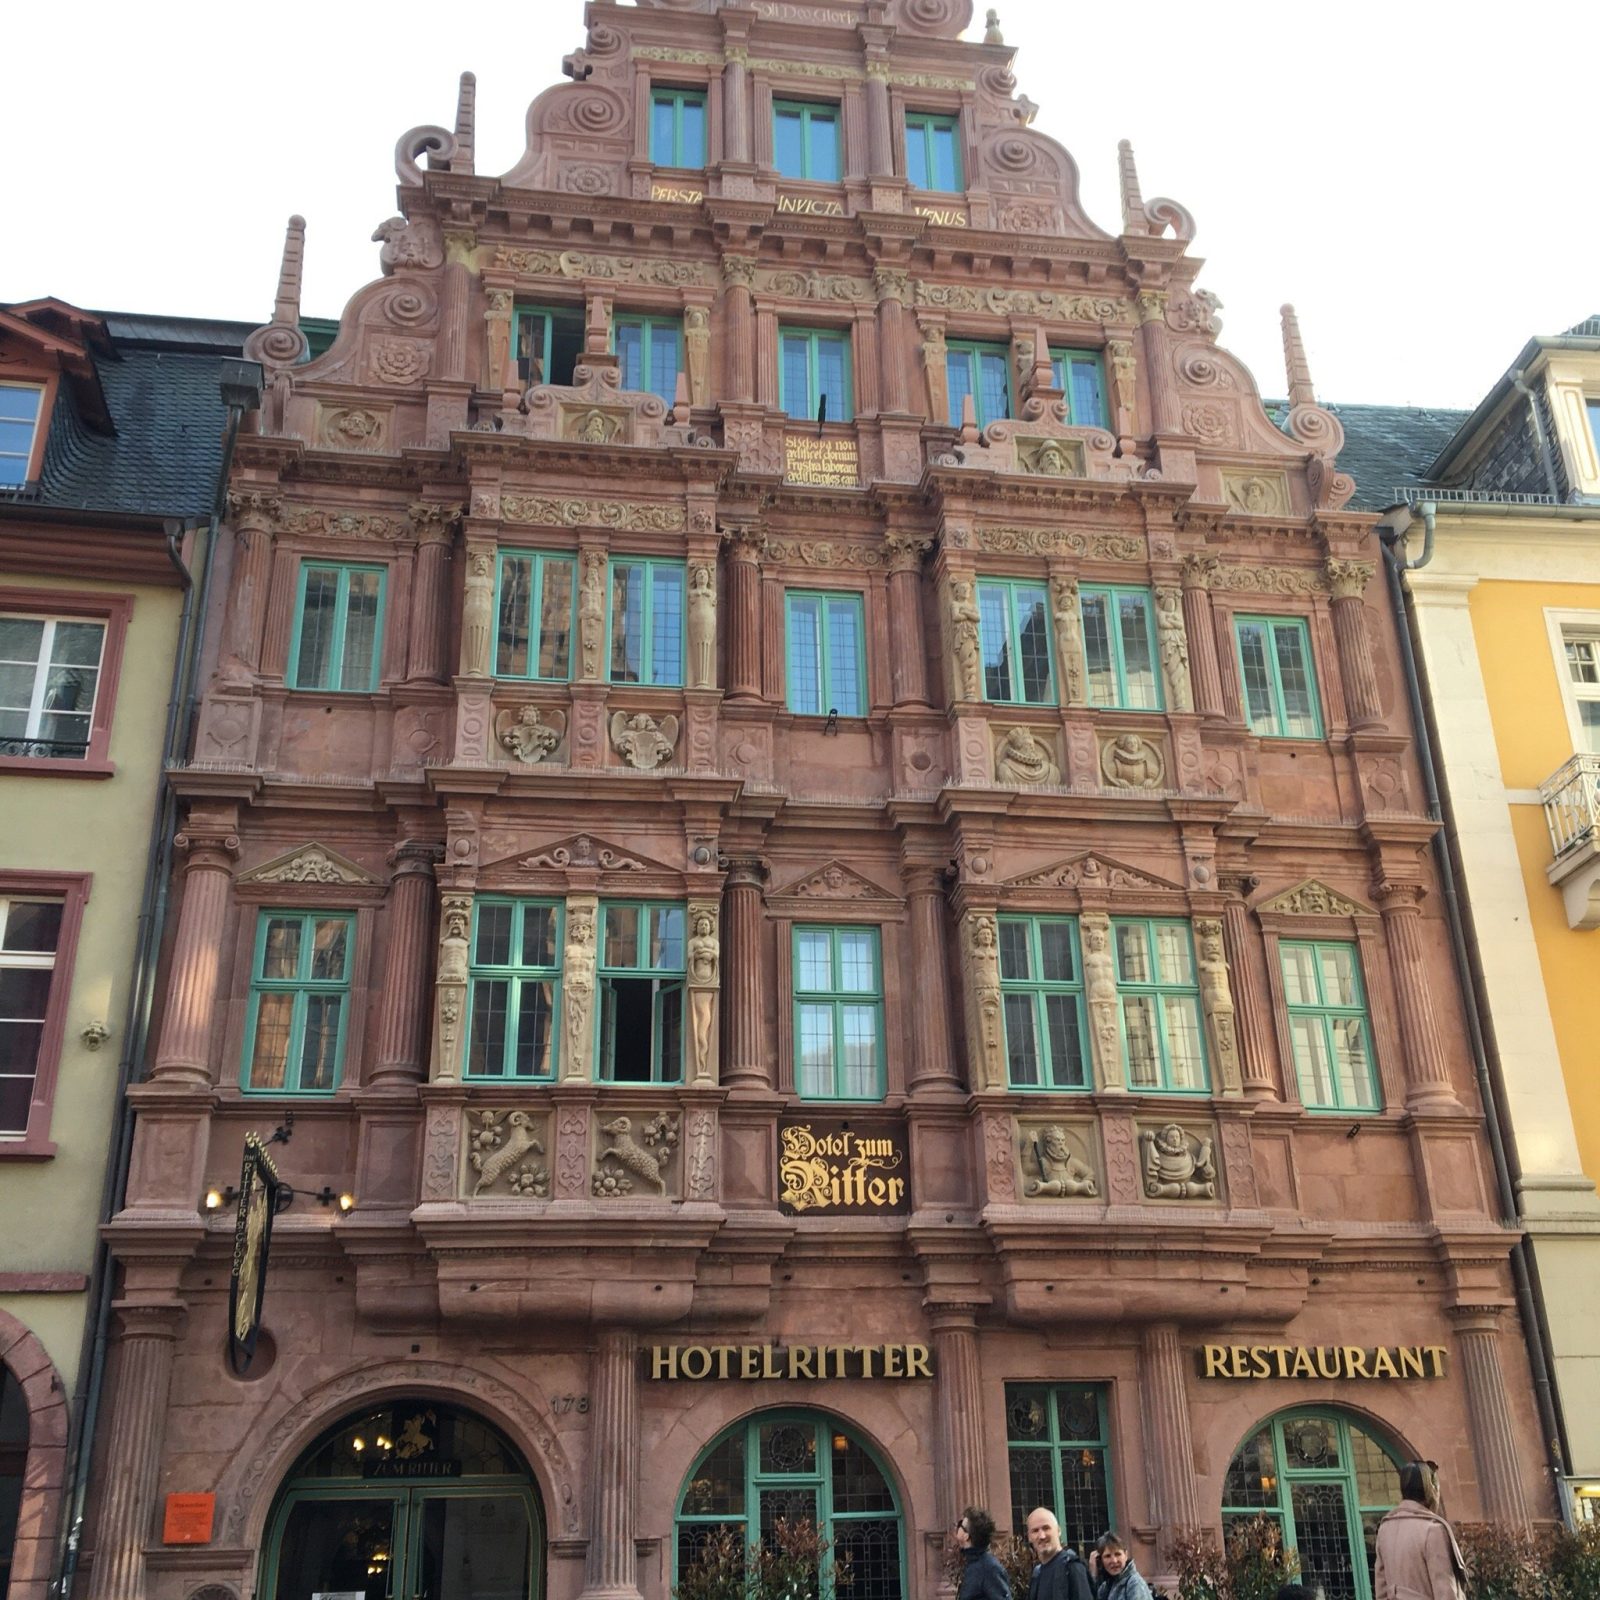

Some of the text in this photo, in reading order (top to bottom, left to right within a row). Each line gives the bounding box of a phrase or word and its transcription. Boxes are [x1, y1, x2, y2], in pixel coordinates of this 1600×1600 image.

[778, 194, 845, 216] INVICTA
[781, 1124, 855, 1160] Hotel
[780, 1156, 905, 1211] Ritter
[651, 1344, 935, 1379] HOTEL RITTER
[1203, 1344, 1449, 1379] RESTAURANT
[550, 1395, 590, 1415] 178
